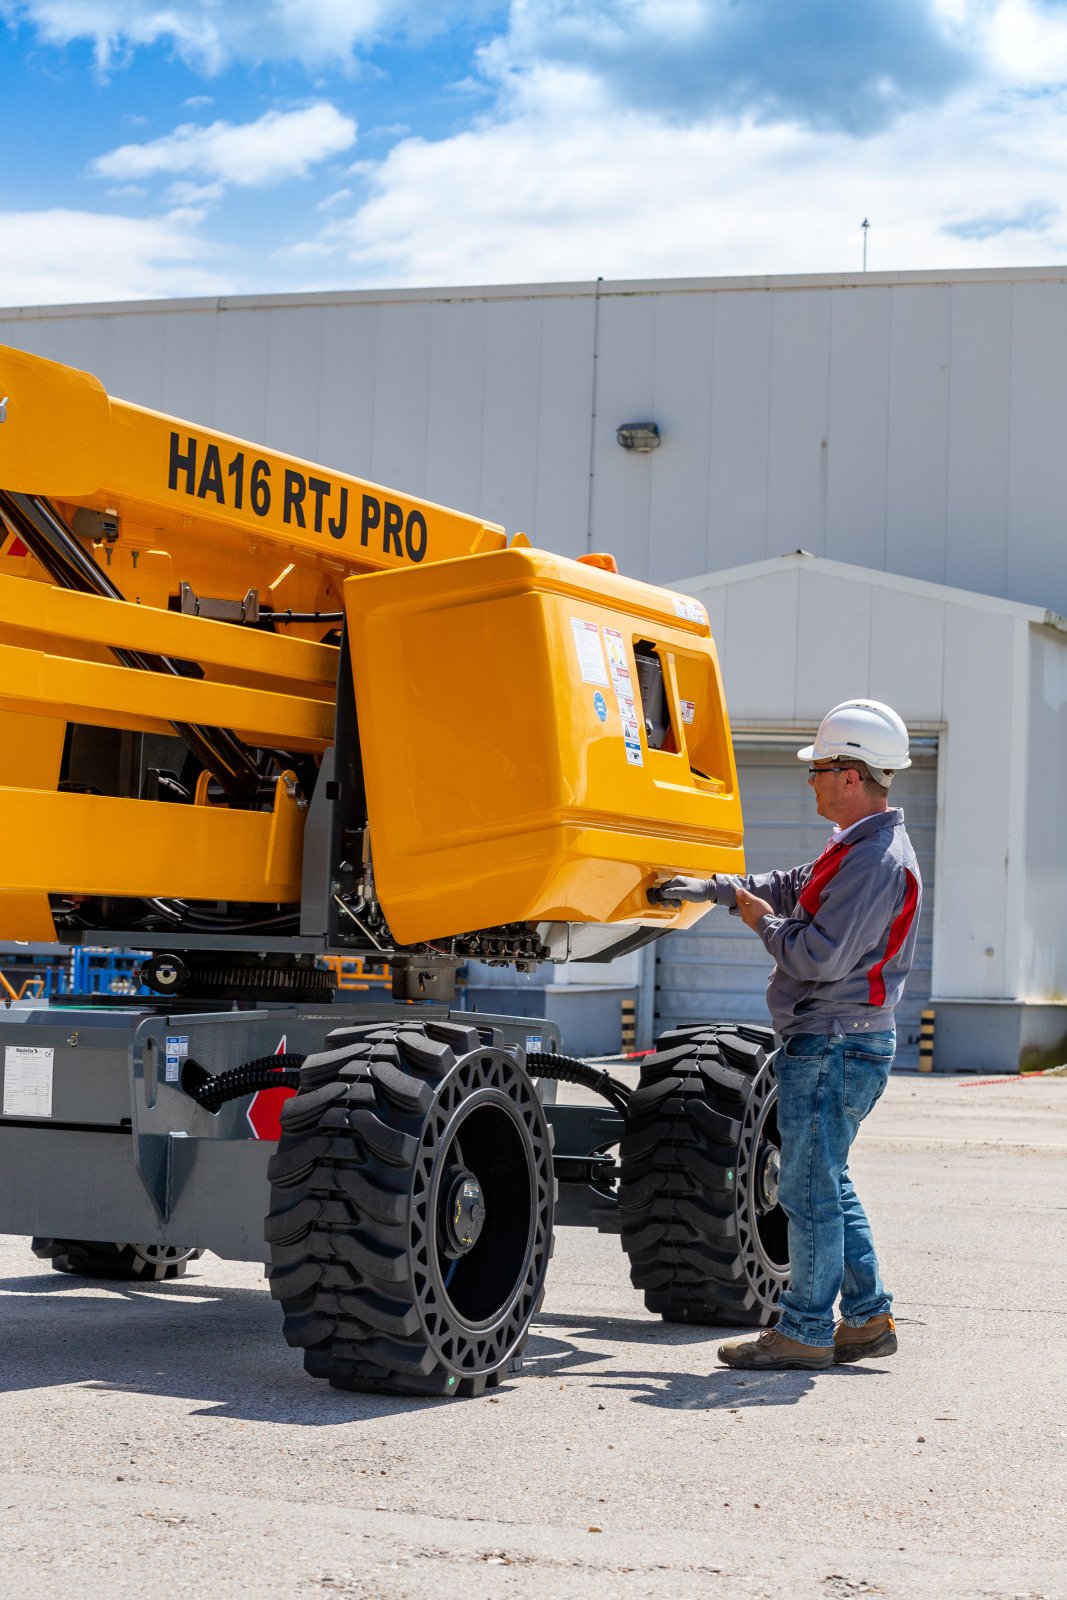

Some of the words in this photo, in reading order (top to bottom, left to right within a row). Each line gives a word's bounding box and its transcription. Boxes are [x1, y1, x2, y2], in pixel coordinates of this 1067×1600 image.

[168, 432, 272, 517] HA16
[283, 469, 349, 540] RTJ
[360, 494, 428, 563] PRO
